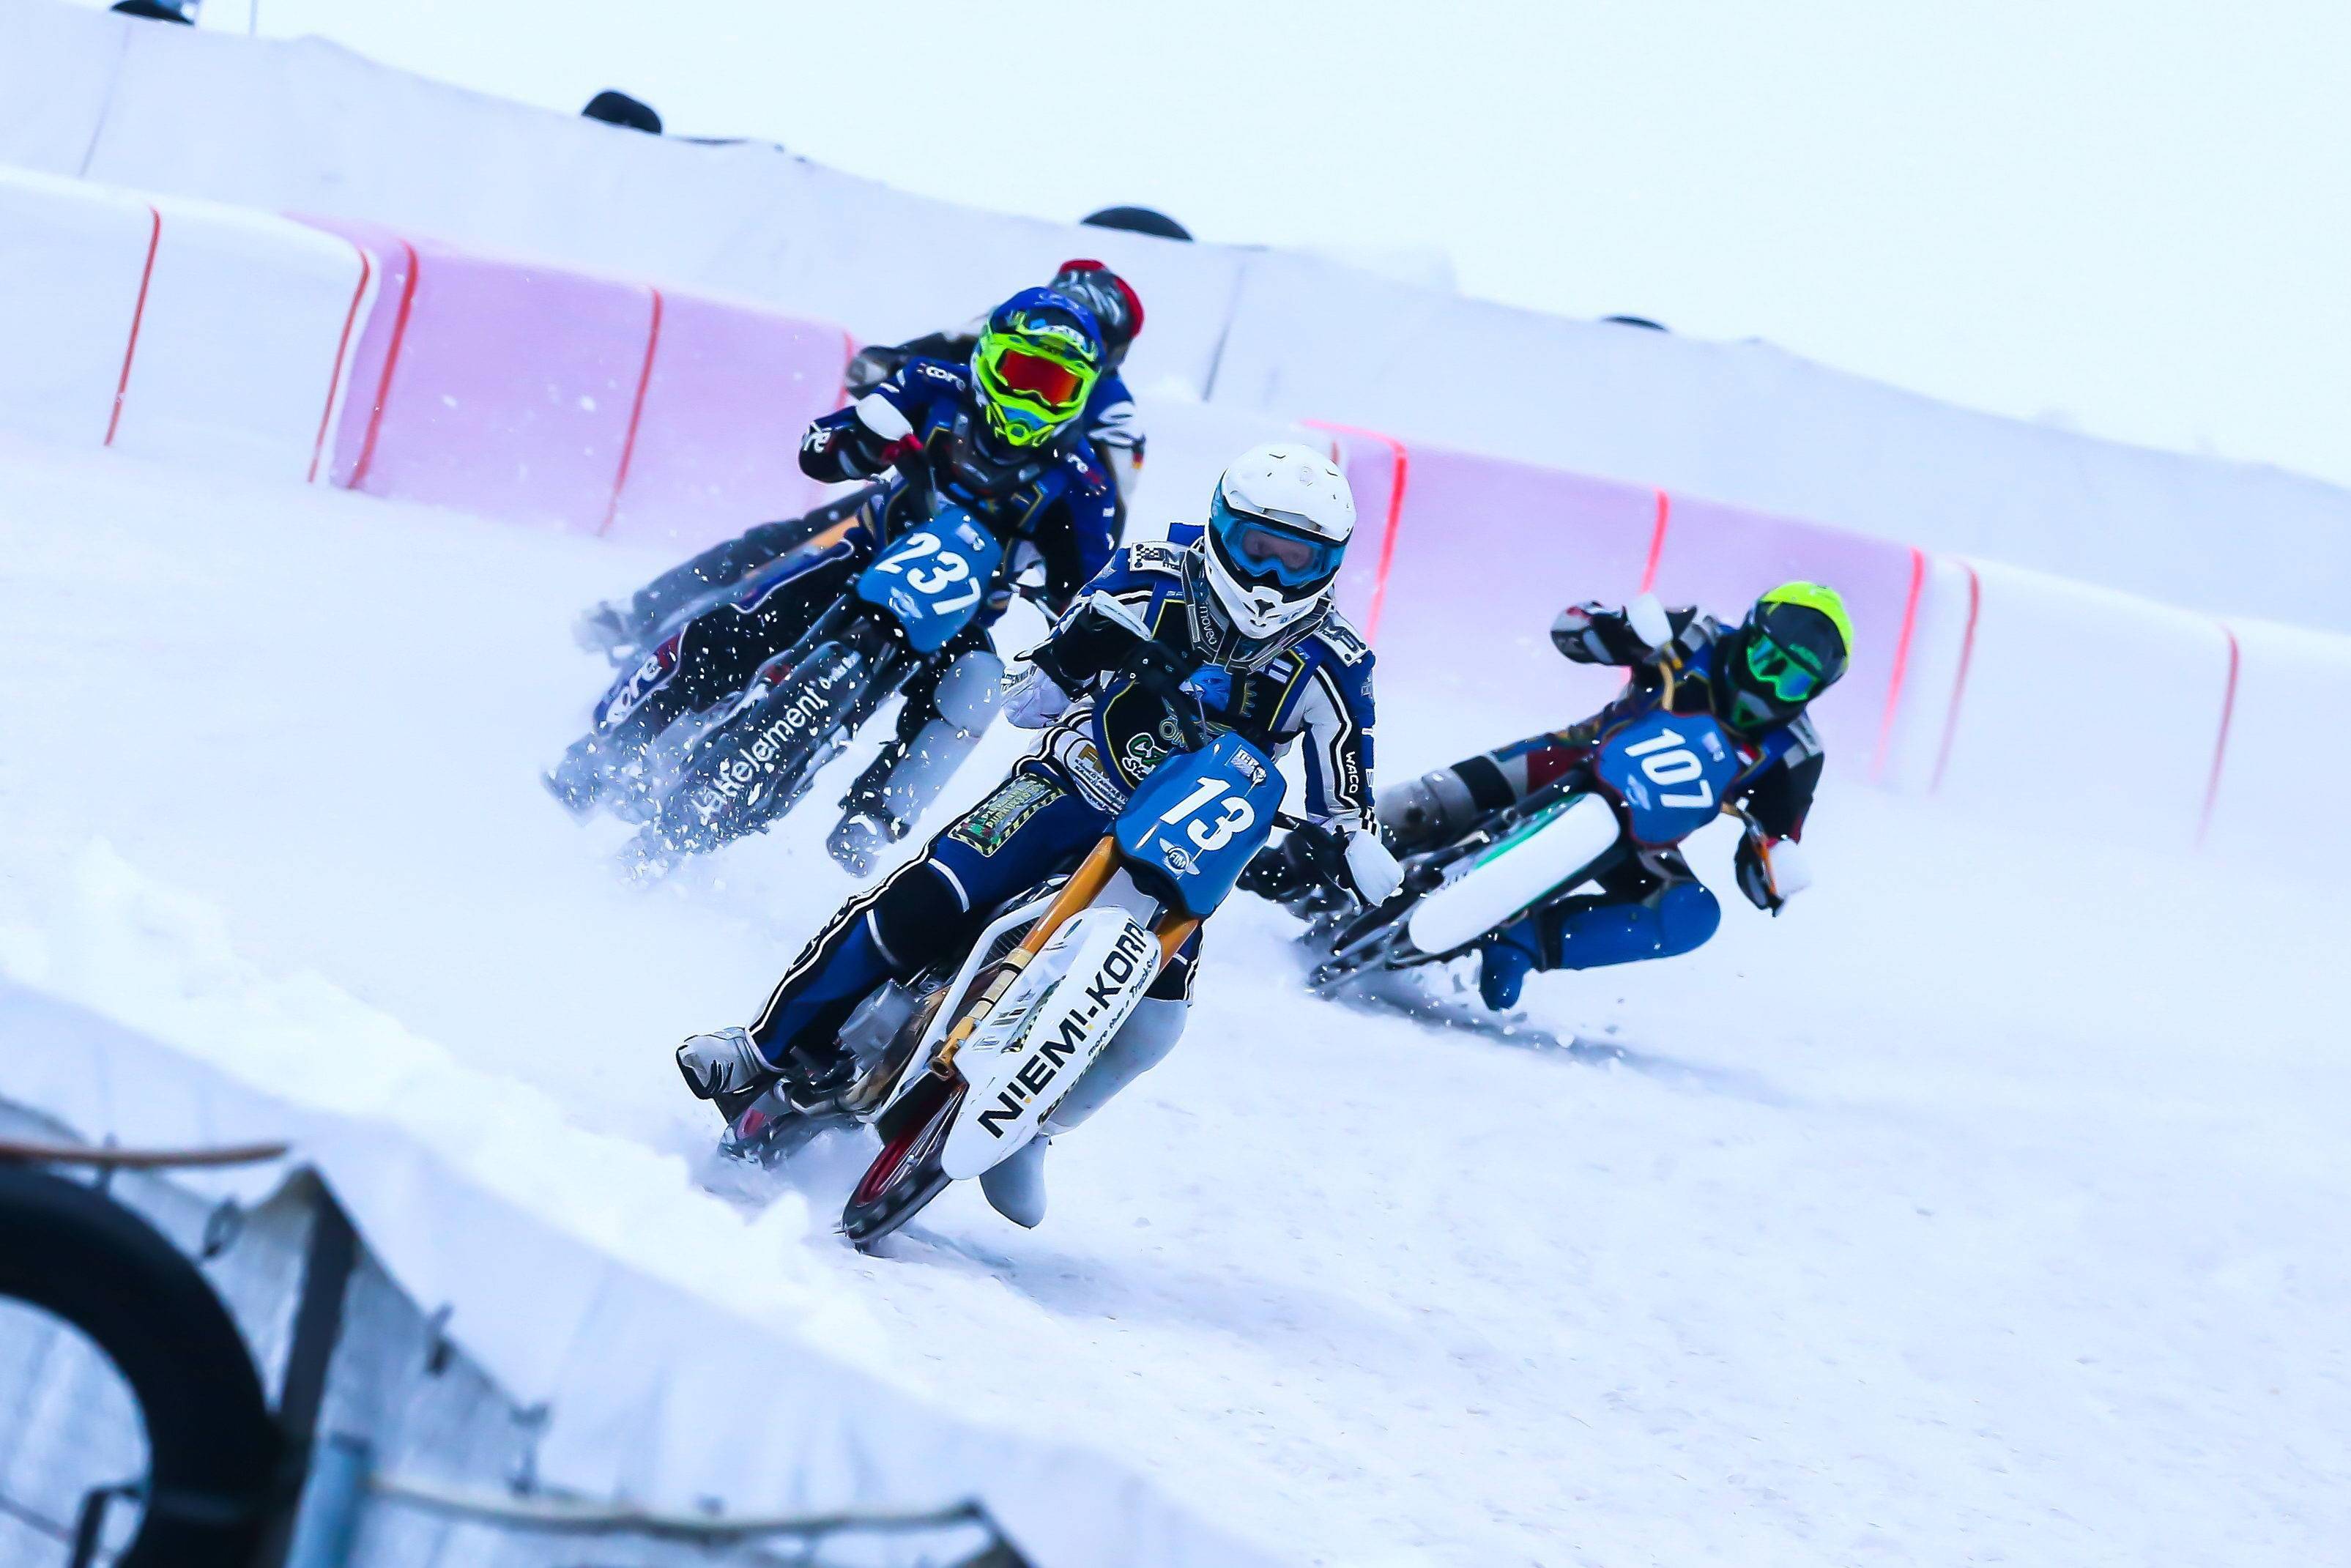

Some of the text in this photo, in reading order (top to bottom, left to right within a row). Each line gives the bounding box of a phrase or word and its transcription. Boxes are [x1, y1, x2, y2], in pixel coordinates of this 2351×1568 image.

[874, 532, 981, 616] 237
[1344, 751, 1359, 794] WACO
[1624, 728, 1714, 808] 107
[1159, 776, 1255, 851] 13
[1169, 850, 1186, 869] FIM
